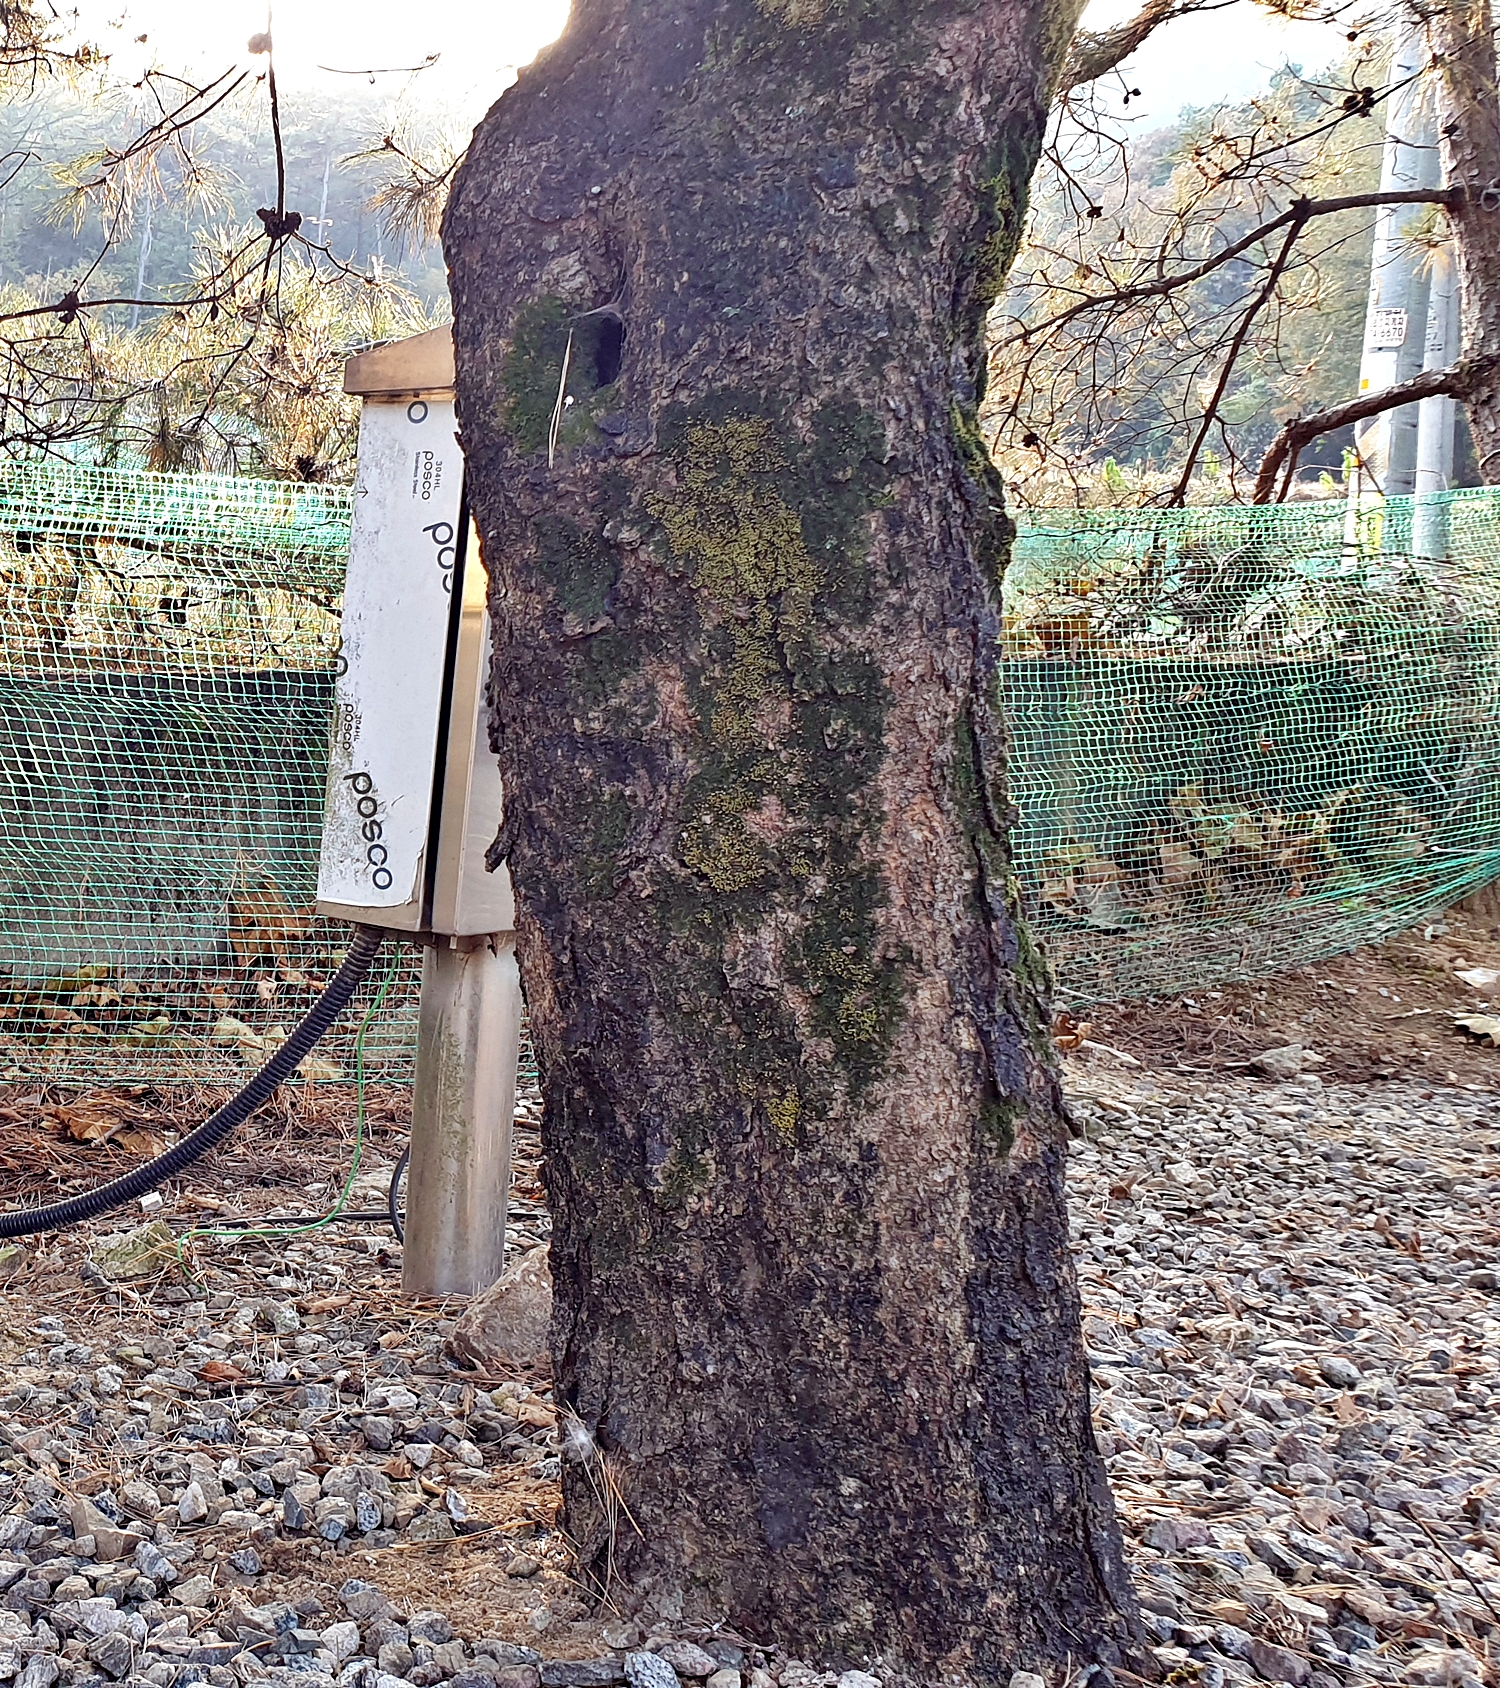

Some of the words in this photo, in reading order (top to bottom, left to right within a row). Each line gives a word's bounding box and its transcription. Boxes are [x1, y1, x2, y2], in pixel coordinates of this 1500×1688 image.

[421, 450, 434, 501] posco
[433, 460, 443, 491] 304HL
[342, 703, 354, 751] posco
[342, 771, 393, 890] posco
